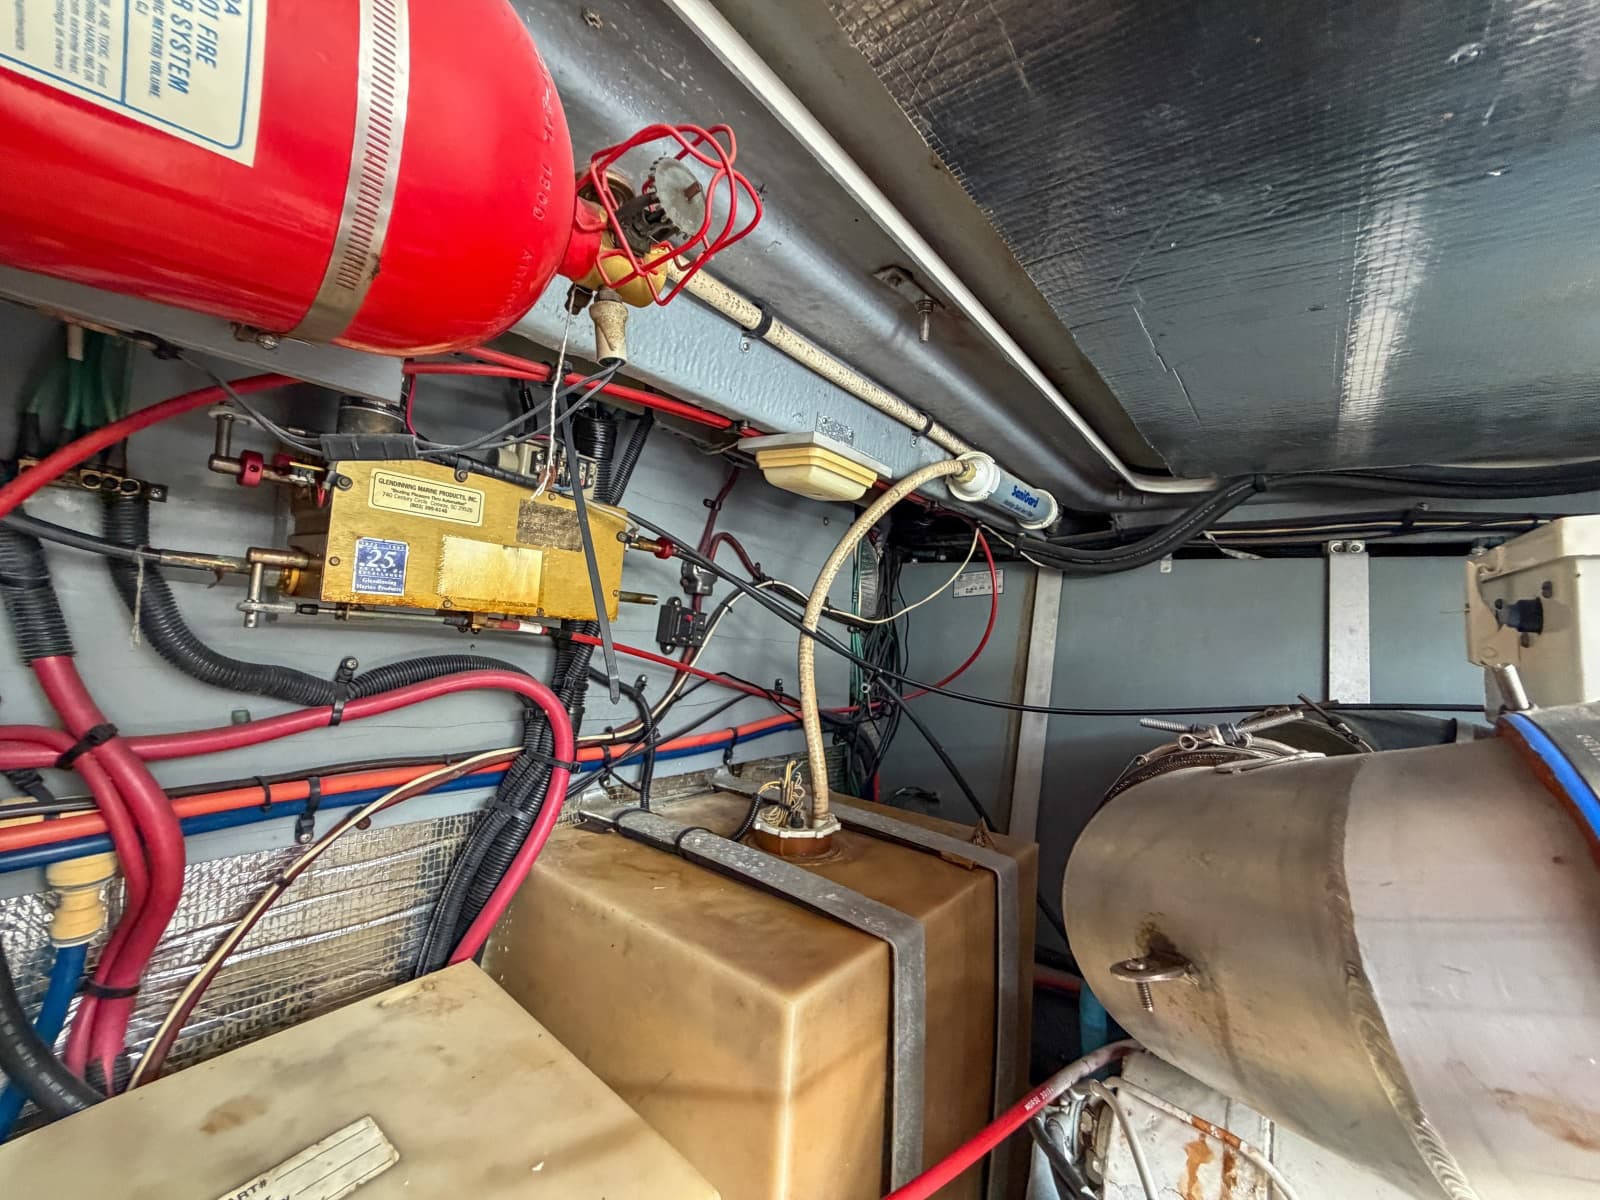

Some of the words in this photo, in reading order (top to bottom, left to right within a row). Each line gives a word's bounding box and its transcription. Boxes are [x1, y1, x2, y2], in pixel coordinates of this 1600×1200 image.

[167, 13, 194, 95] SYSTEM
[195, 23, 218, 69] FIRE
[148, 60, 162, 98] VOLUME
[378, 477, 417, 491] GLENDINNING
[417, 485, 438, 495] MARINE
[365, 549, 397, 568] 25
[361, 577, 397, 586] Glendinning
